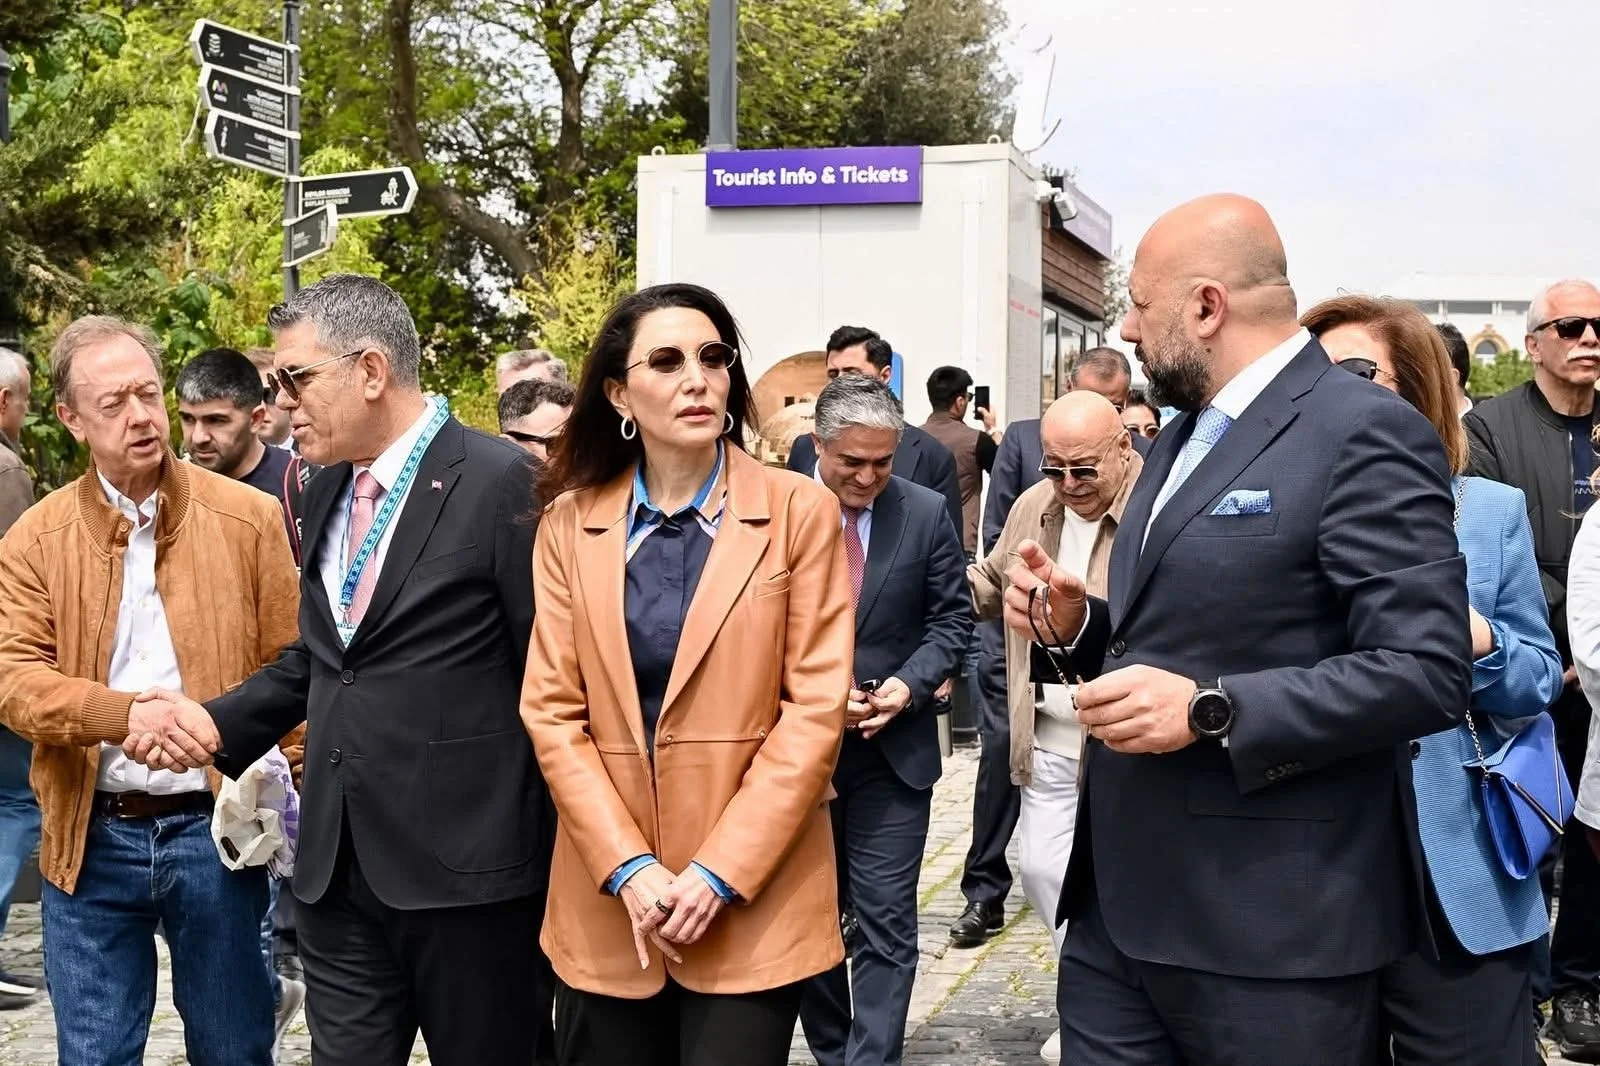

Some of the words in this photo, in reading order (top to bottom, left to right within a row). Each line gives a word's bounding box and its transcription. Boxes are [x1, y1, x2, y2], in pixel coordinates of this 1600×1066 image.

[712, 167, 776, 187] Tourist
[780, 167, 817, 185] Info
[821, 166, 837, 184] &
[840, 165, 909, 184] Tickets
